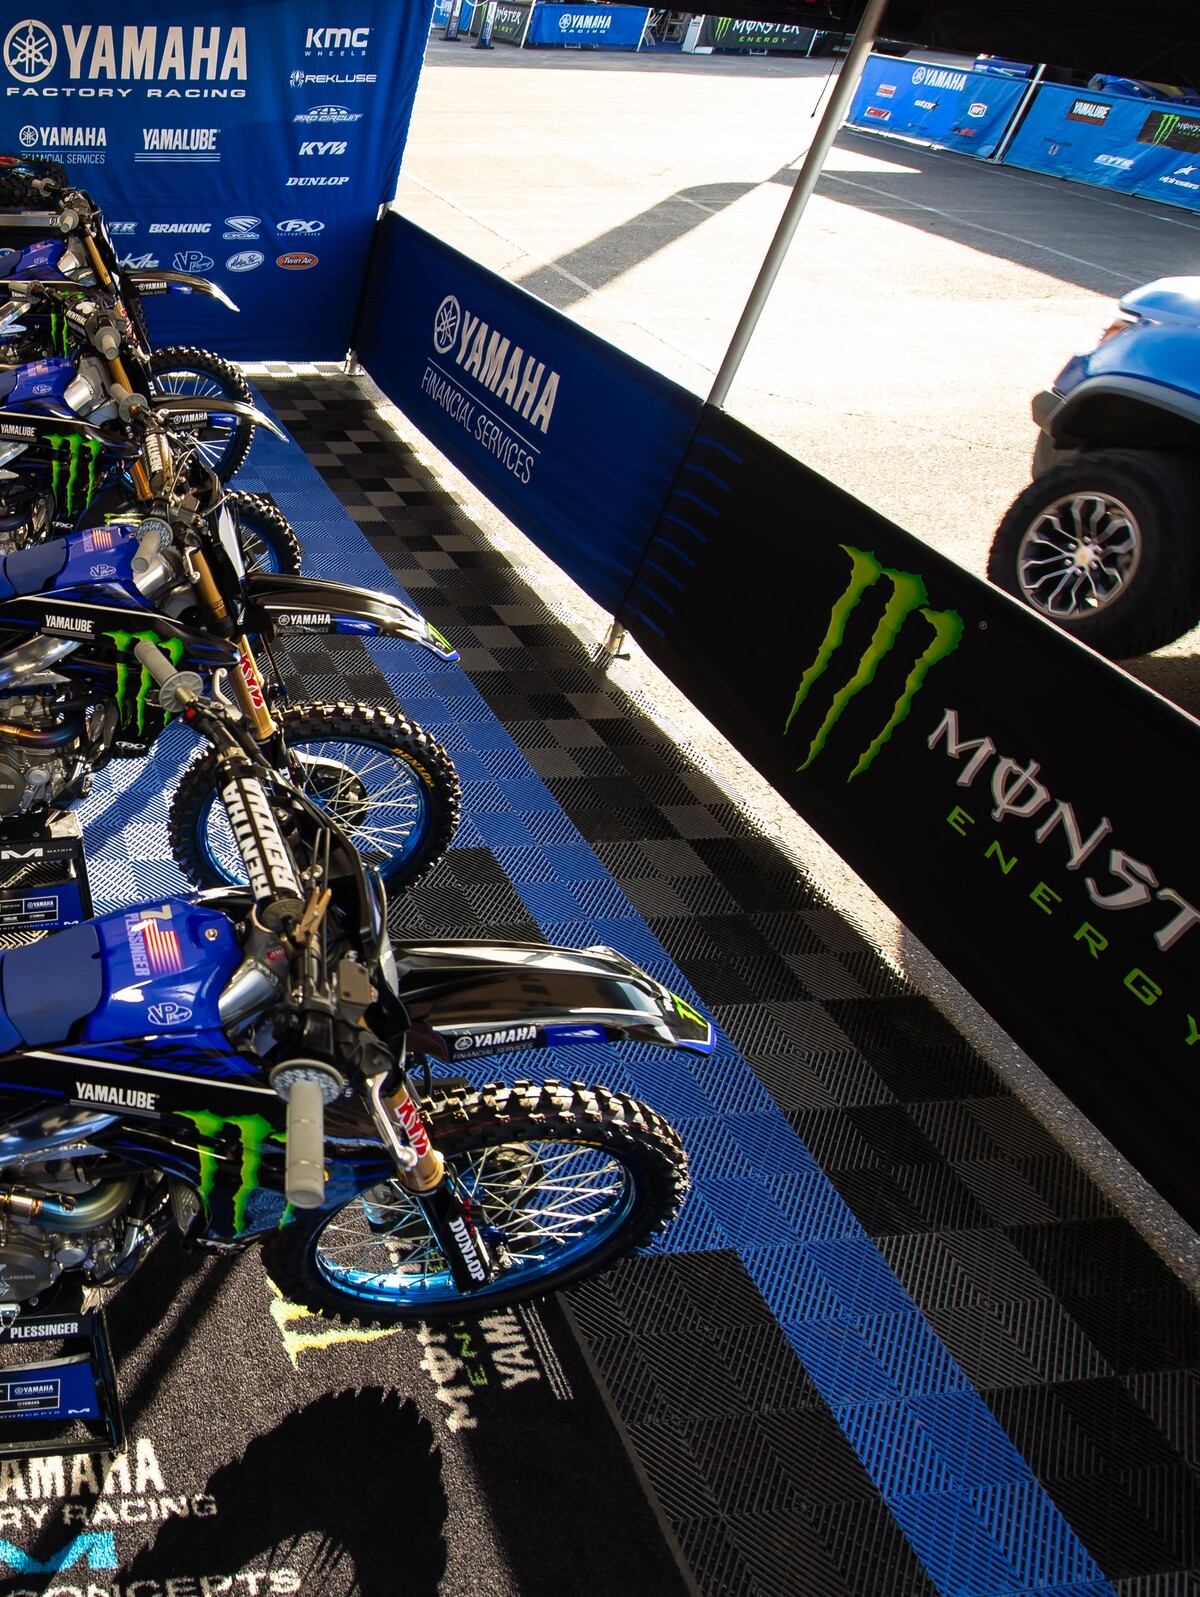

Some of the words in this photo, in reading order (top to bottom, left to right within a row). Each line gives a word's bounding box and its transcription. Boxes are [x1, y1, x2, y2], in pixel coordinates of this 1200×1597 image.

[571, 15, 611, 29] YAMAHA
[732, 19, 800, 35] MONSTER
[305, 28, 369, 48] KMC
[62, 25, 248, 80] YAMAHA
[305, 75, 377, 83] REKLUSE
[924, 69, 968, 91] YAMAHA
[6, 87, 133, 98] FACTORY
[146, 87, 247, 98] RACING
[1072, 102, 1110, 119] YAMALUBE
[40, 127, 107, 146] YAMAHA
[143, 129, 217, 150] YAMALUBE
[299, 141, 347, 155] KYB
[67, 154, 105, 164] SERVICES
[286, 177, 349, 186] DUNLOP
[149, 223, 212, 233] BRAKING
[145, 282, 167, 290] YAMAHA
[455, 310, 560, 434] YAMAHA
[181, 412, 208, 422] YAMAHA
[421, 366, 471, 432] FINANCIAL
[474, 415, 534, 484] SERVICES
[0, 424, 37, 437] YAMALUBE
[144, 434, 163, 473] RENTHA
[45, 614, 92, 633] YAMALUBE
[290, 614, 330, 625] YAMAHA
[239, 651, 263, 709] KYB
[222, 780, 272, 901] RENTHA
[32, 900, 54, 908] YAMAHA
[140, 904, 173, 921] 7
[124, 913, 151, 977] PLESSINGER
[473, 1025, 537, 1048] YAMAHA
[453, 1047, 494, 1061] FINANCIAL
[496, 1043, 534, 1055] SERVICES
[75, 1082, 157, 1110] YAMALUBE
[396, 1095, 432, 1159] KYB
[448, 1216, 487, 1283] DUNLOP
[10, 1322, 79, 1339] PLESSINGER
[23, 1385, 54, 1394] YAMAHA
[63, 1494, 219, 1527] RACING
